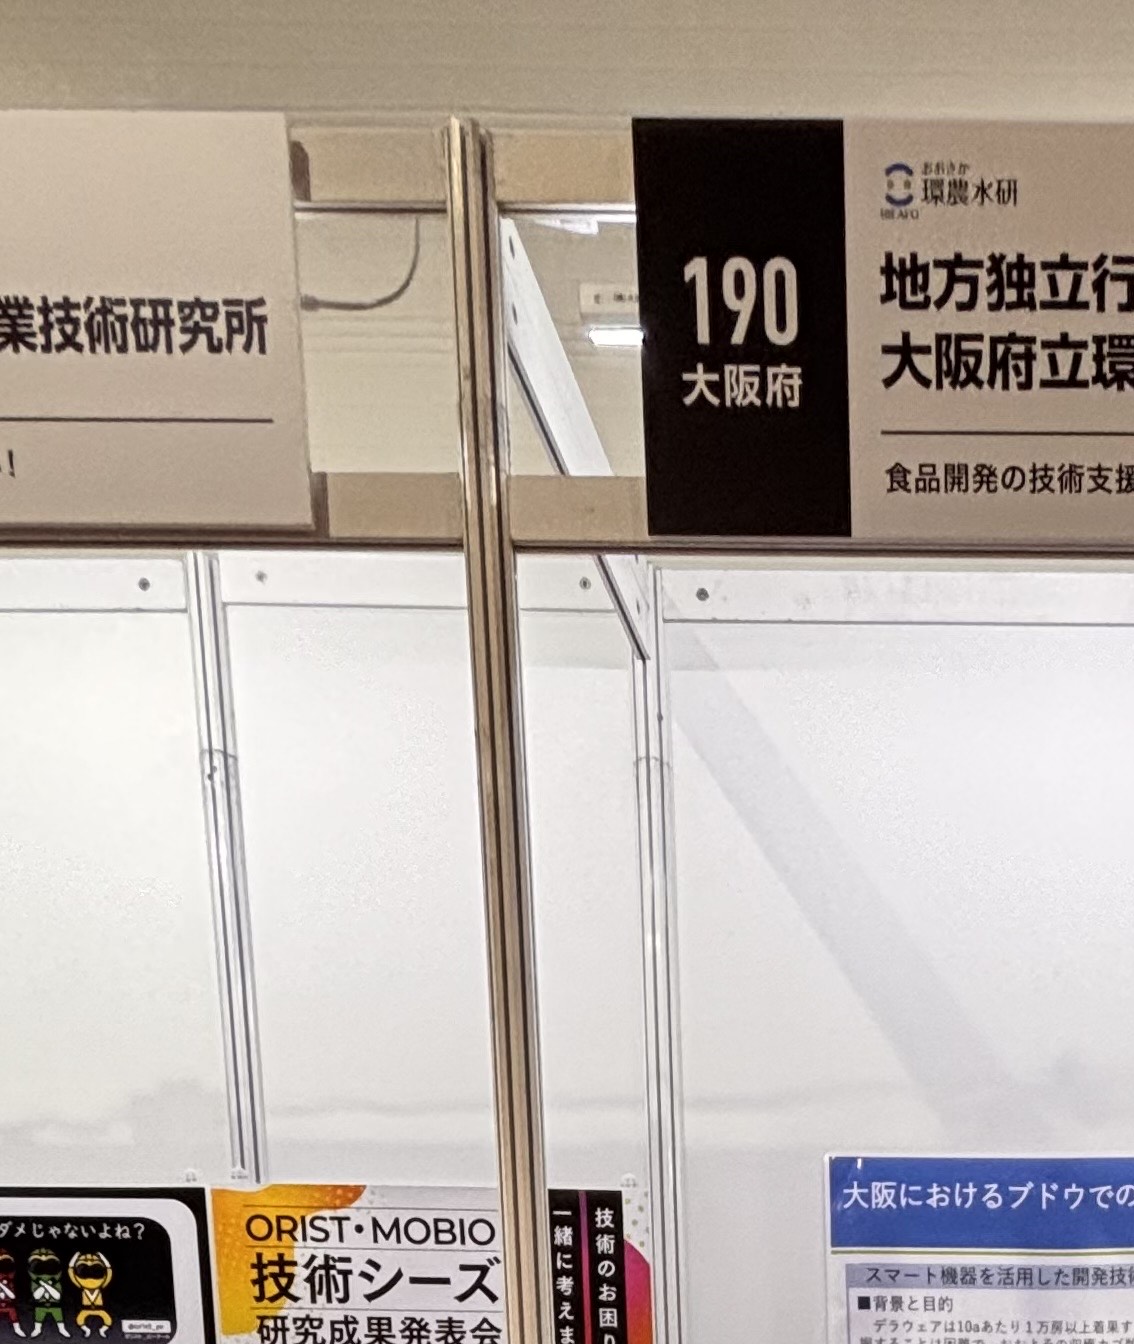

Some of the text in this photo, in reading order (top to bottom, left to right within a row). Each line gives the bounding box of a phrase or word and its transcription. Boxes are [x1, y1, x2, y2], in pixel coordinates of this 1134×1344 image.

[921, 177, 1018, 206] 環農水研
[0, 295, 268, 355] 業技術研究所
[683, 256, 799, 347] 190
[682, 363, 803, 409] 大阪府
[250, 1252, 501, 1305] 技術シーズ
[873, 1295, 953, 1312] 背景と目的
